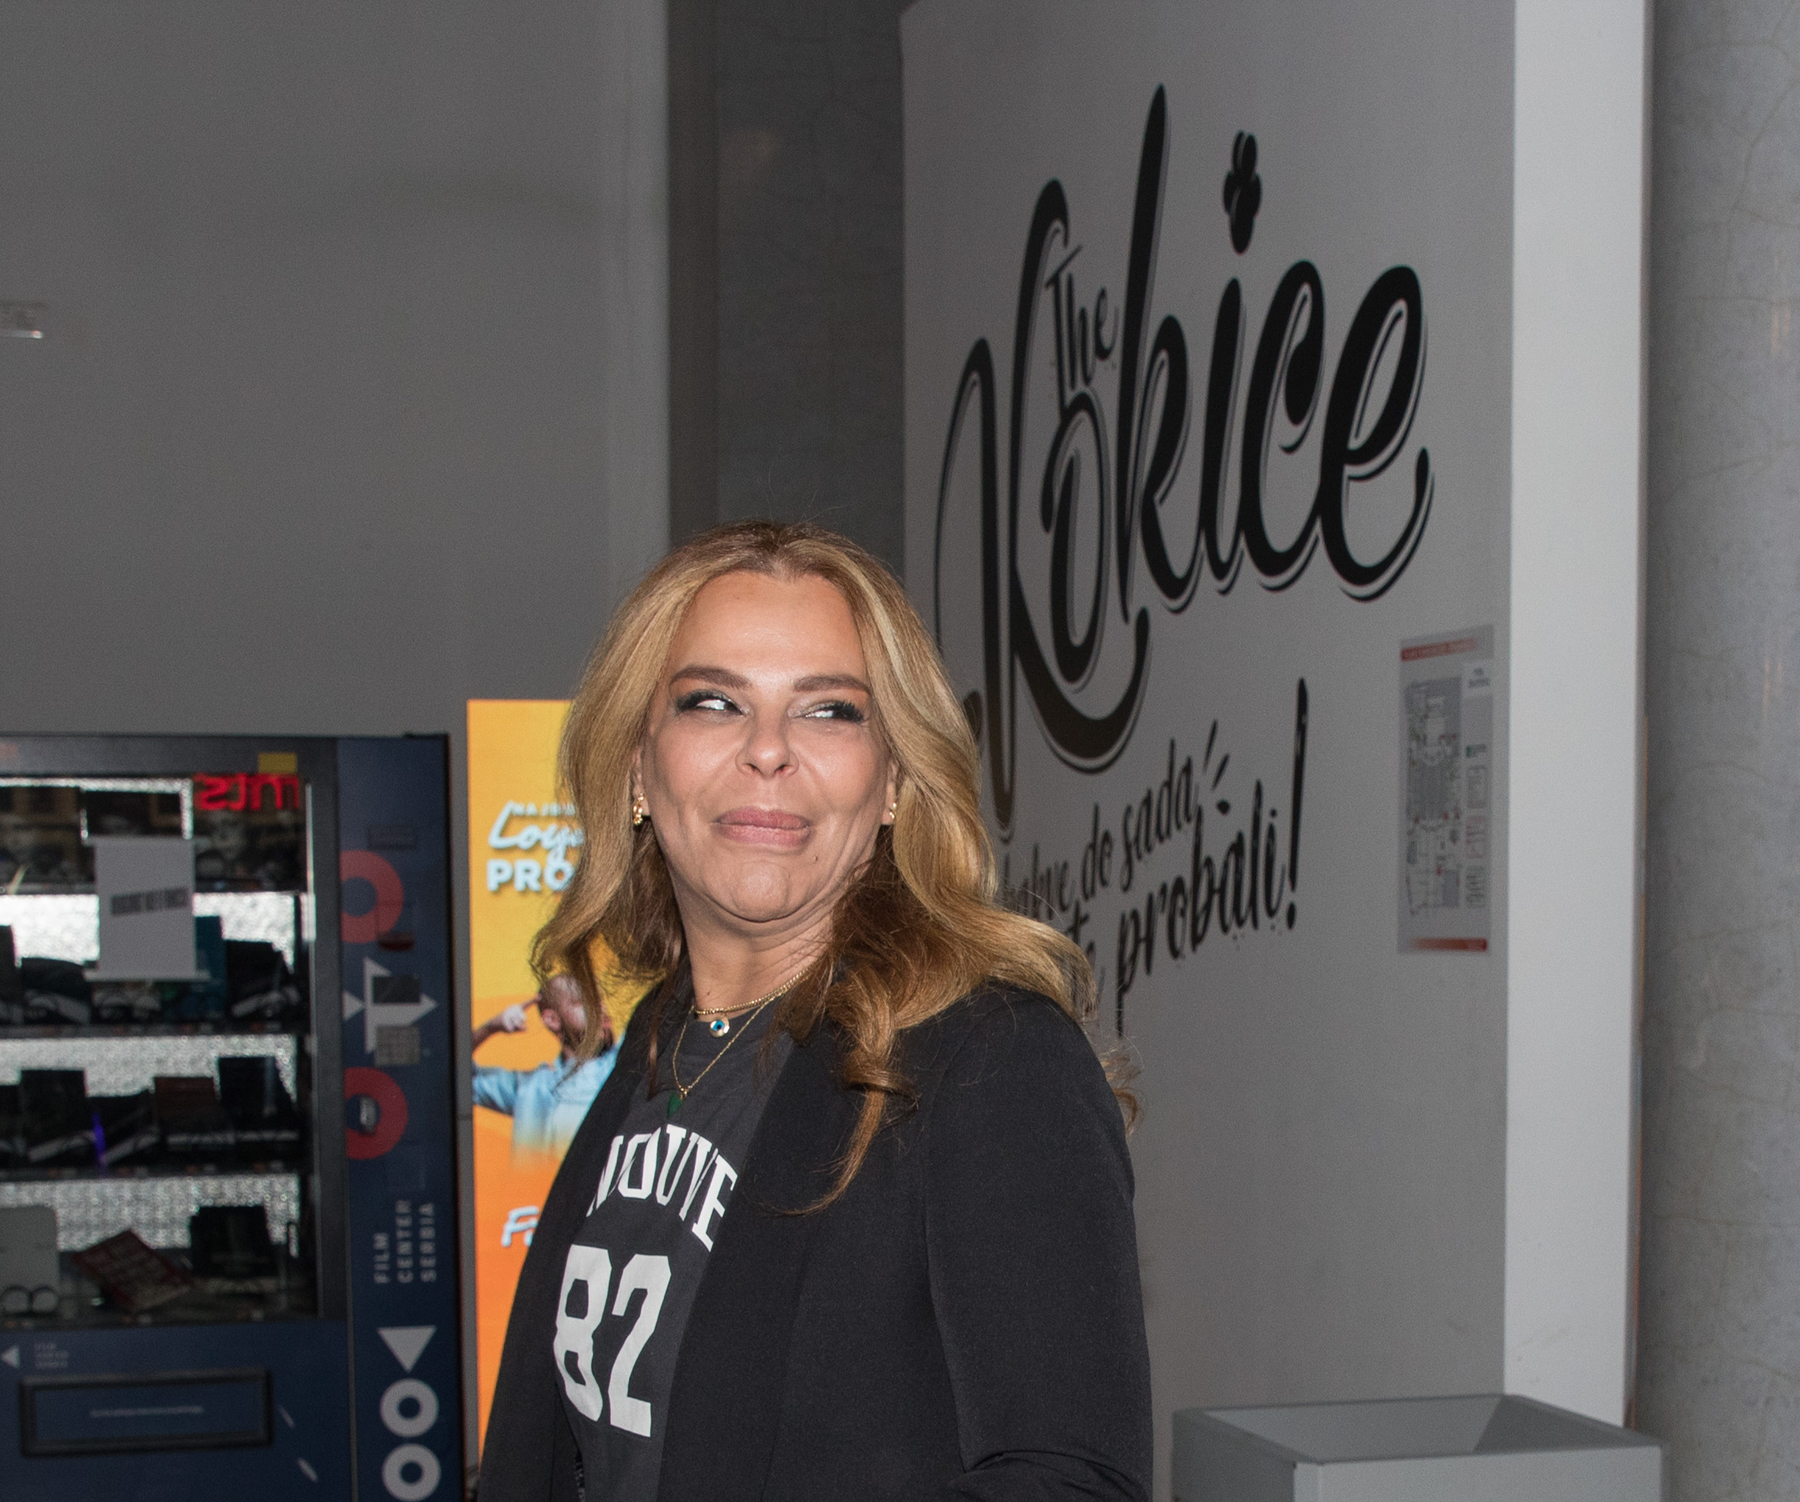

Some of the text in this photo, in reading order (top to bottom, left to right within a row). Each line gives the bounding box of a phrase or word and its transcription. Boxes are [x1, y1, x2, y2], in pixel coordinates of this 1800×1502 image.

[1046, 244, 1116, 400] The
[934, 82, 1434, 842] Kokice
[1119, 737, 1196, 894] sada
[373, 1232, 390, 1284] FILM
[552, 1243, 673, 1439] 82
